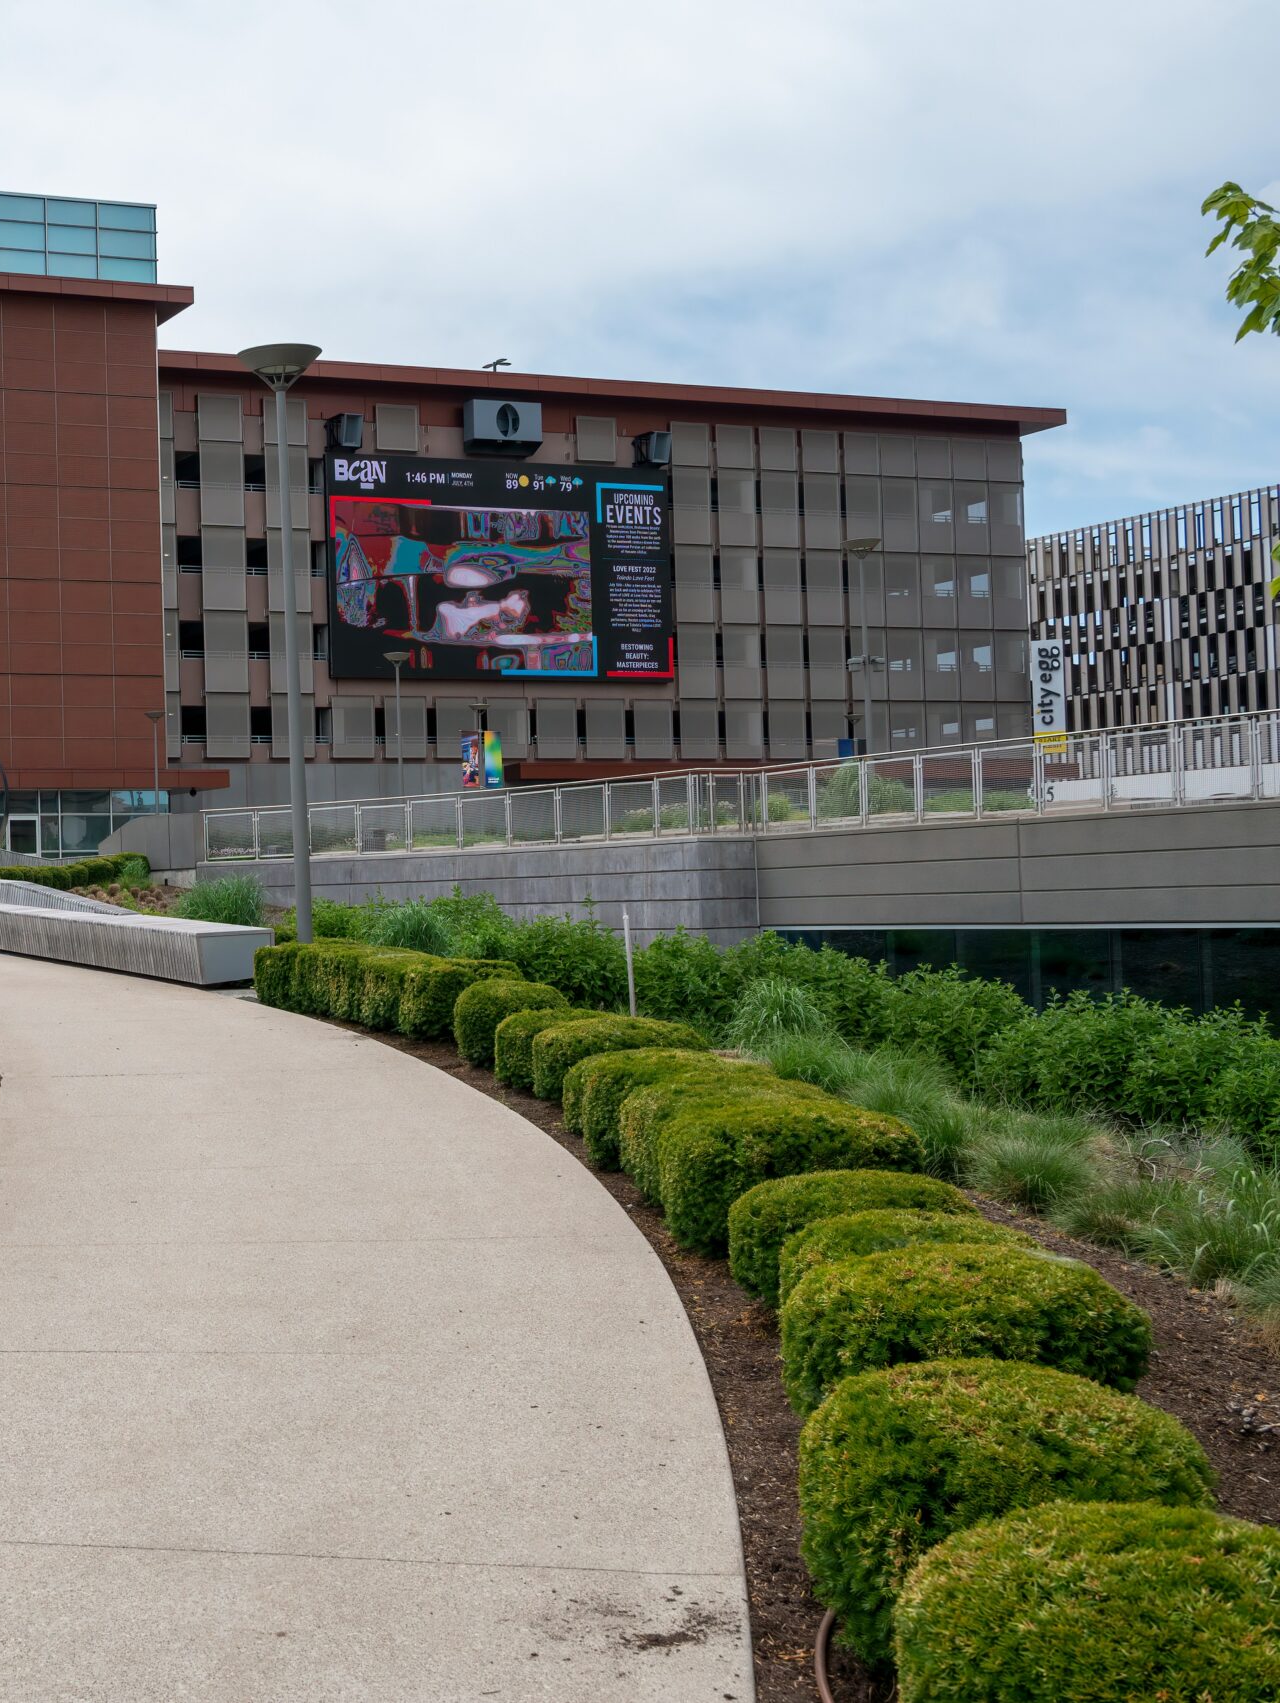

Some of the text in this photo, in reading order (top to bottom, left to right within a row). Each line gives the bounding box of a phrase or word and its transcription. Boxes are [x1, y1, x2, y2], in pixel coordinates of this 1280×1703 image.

[406, 472, 446, 484] 1:46 PM
[505, 472, 519, 480] NOW
[505, 479, 519, 489] 89
[533, 480, 545, 491] 91
[559, 481, 573, 492] 79
[613, 493, 654, 505] UPCOMING
[606, 505, 662, 525] EVENTS
[613, 565, 657, 574] LOVE FEST 2022
[620, 643, 654, 651] BESTOWING
[625, 652, 650, 660] BEAUTY:
[616, 661, 659, 669] MASTERPIECES
[1037, 645, 1061, 684] egg
[1036, 687, 1061, 726] city
